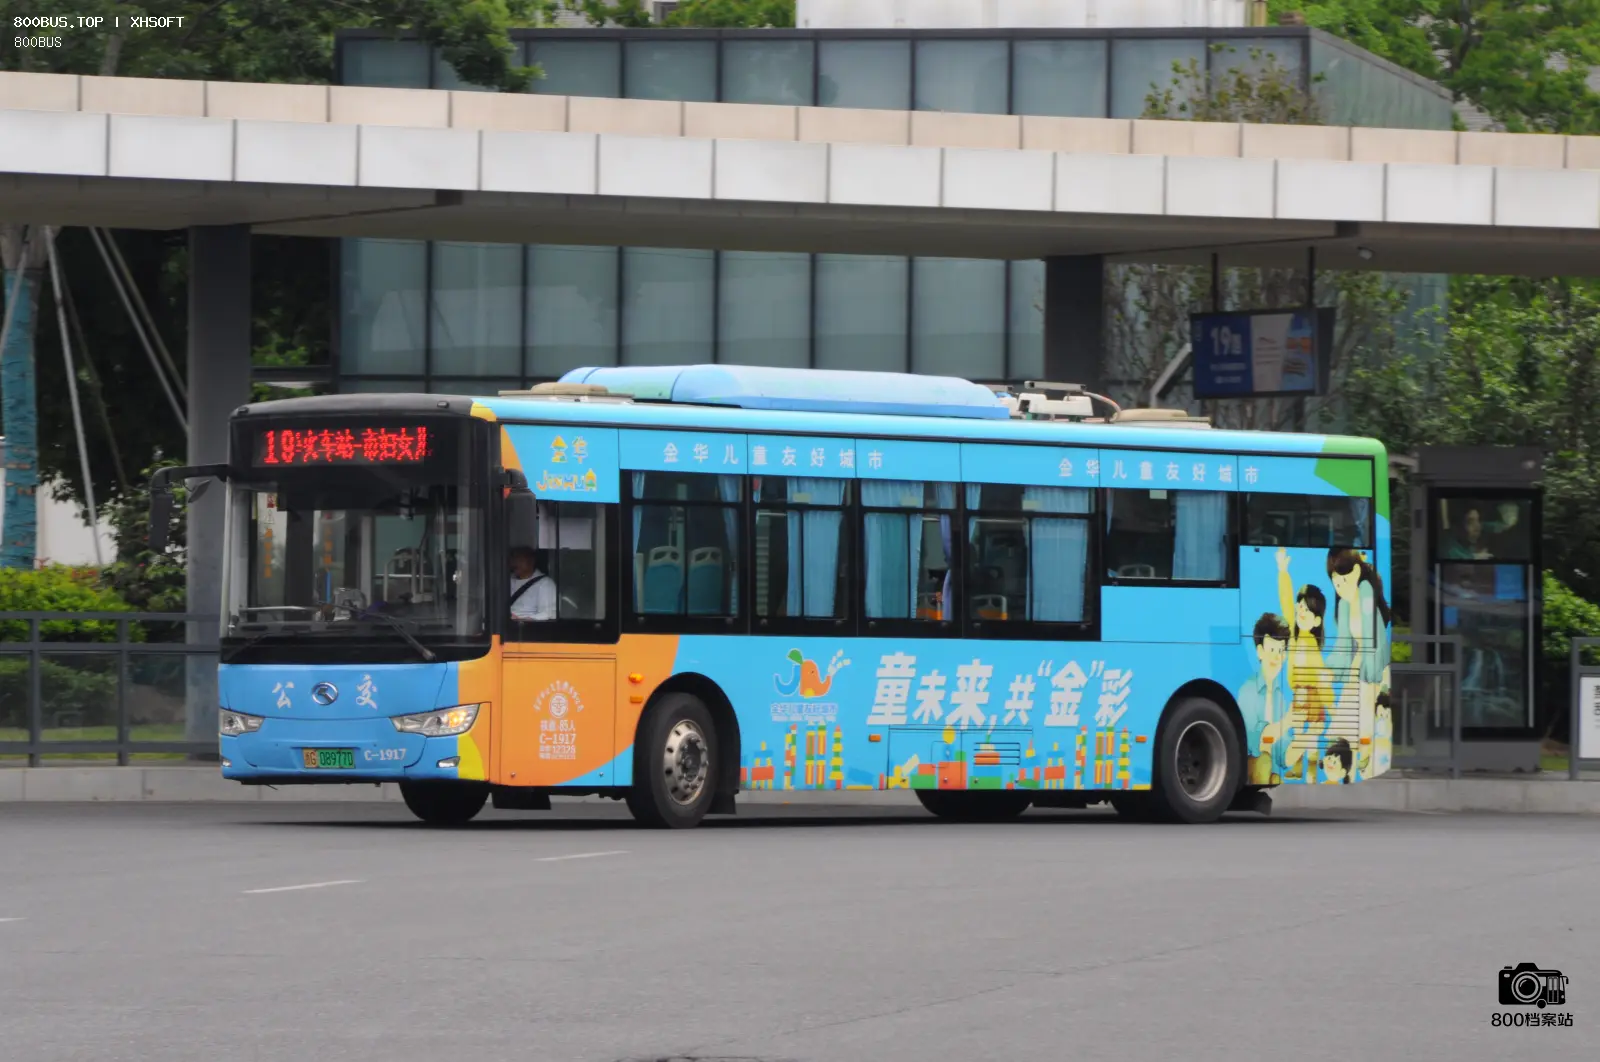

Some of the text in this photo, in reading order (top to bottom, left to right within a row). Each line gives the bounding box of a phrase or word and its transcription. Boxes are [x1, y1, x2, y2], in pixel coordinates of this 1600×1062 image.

[550, 434, 588, 464] 金华
[662, 442, 884, 470] 金华儿童友好城市
[1058, 457, 1259, 485] 金华儿童友好城市
[364, 748, 406, 761] C-1917
